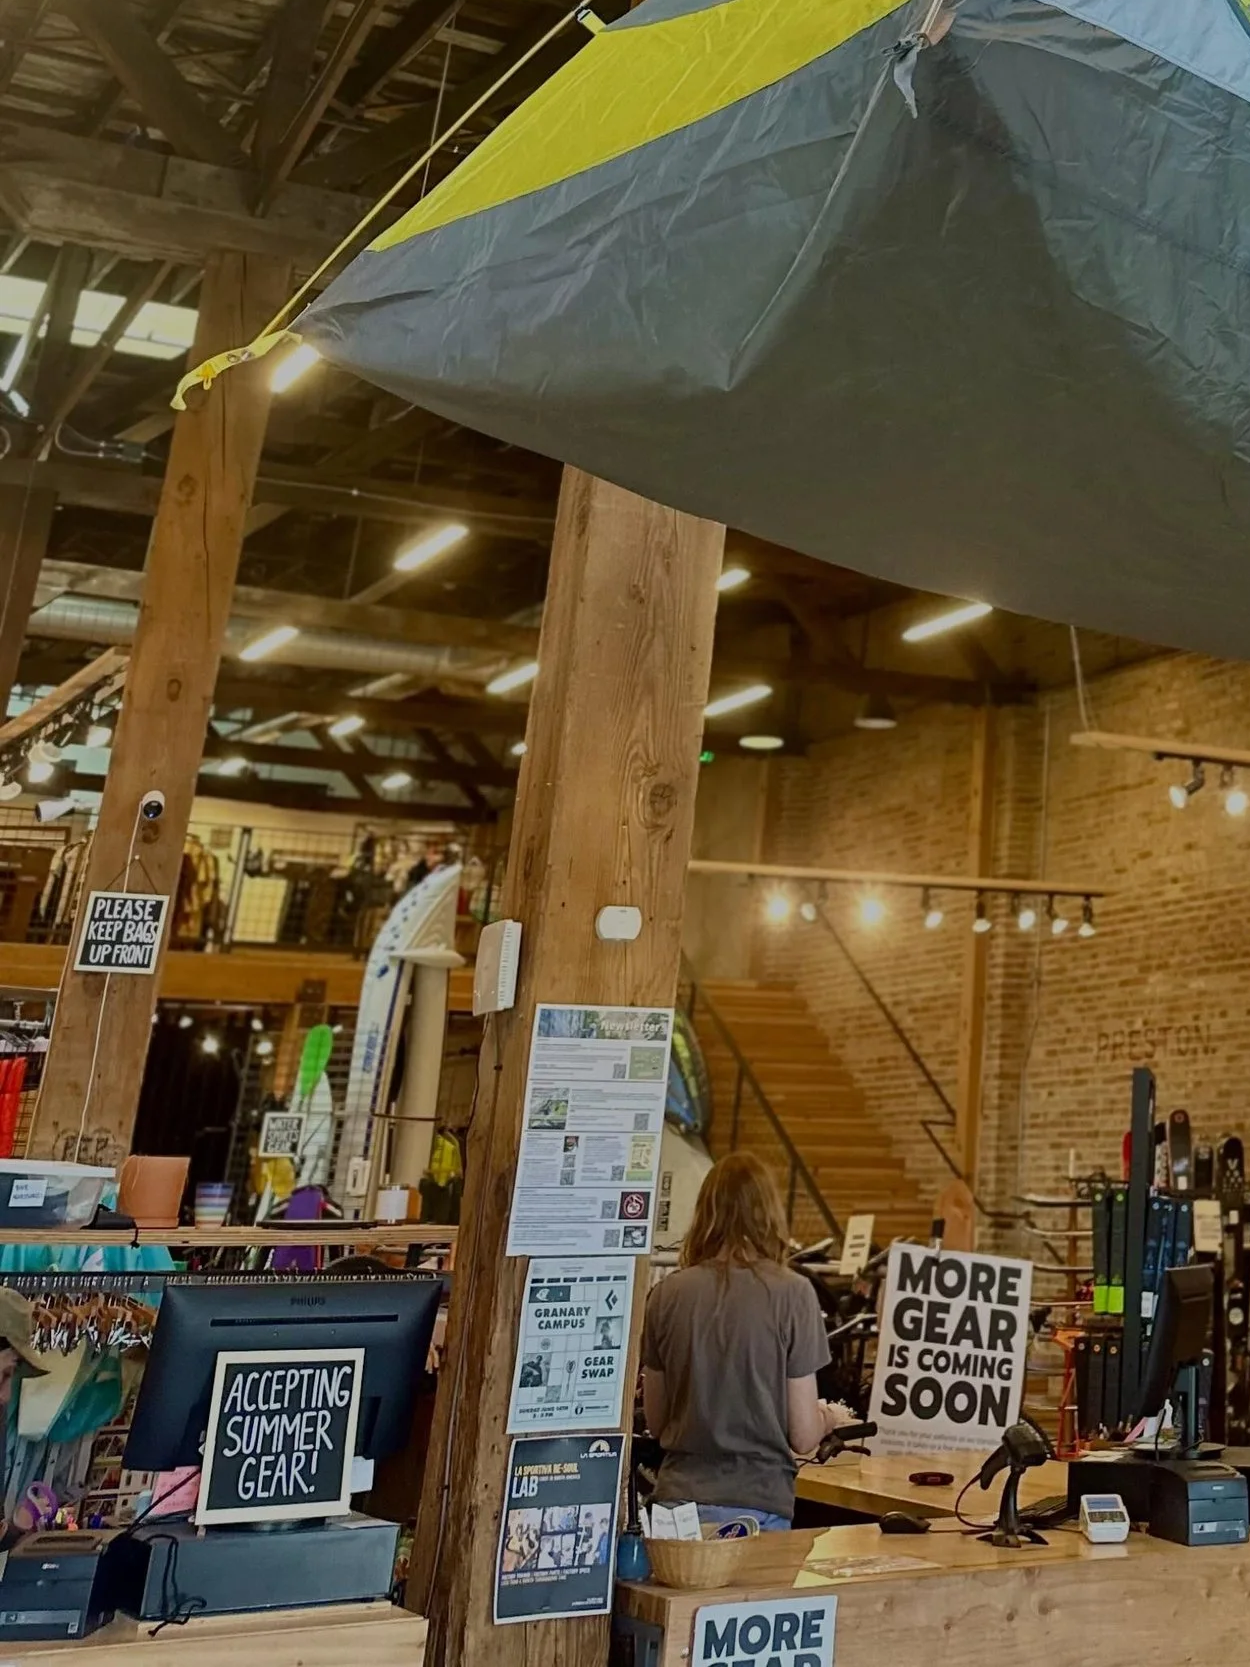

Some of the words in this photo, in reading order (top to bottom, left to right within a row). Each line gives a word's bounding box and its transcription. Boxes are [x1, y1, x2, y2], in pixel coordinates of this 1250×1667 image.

[94, 898, 156, 920] PLEASE
[87, 920, 122, 941] KEEP
[122, 920, 159, 943] BAGS
[89, 944, 112, 964] UP
[111, 944, 153, 965] FRONT
[897, 1252, 1022, 1307] MORE
[534, 1306, 591, 1318] GRANARY
[538, 1318, 585, 1330] CAMPUS
[893, 1297, 1018, 1353] GEAR
[581, 1368, 614, 1379] SWAP
[584, 1356, 614, 1366] GEAR
[887, 1344, 910, 1369] IS
[917, 1348, 1013, 1381] COMING
[224, 1366, 352, 1413] ACCEPTING
[880, 1373, 1010, 1428] SOON
[223, 1410, 333, 1457] SUMMER
[237, 1451, 319, 1500] GEAR!
[511, 1476, 538, 1498] LAB
[703, 1609, 825, 1660] MORE
